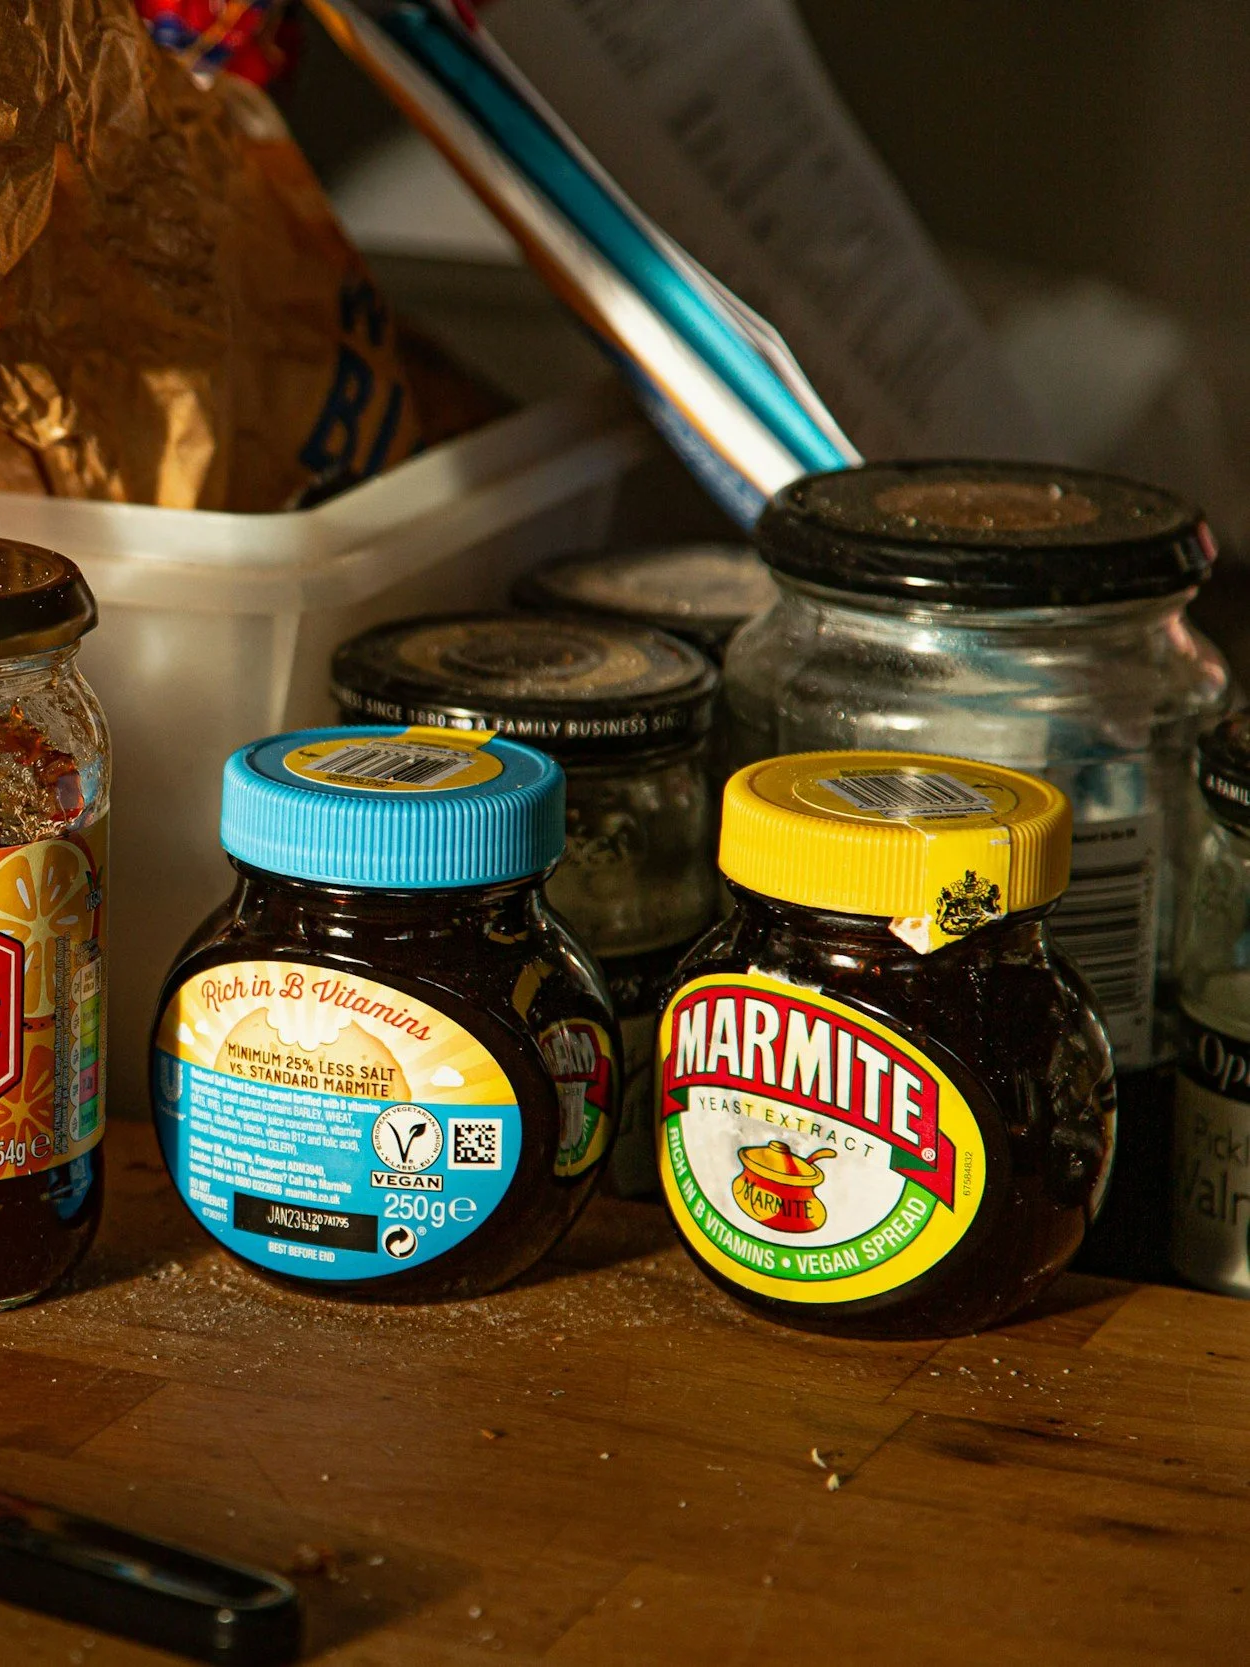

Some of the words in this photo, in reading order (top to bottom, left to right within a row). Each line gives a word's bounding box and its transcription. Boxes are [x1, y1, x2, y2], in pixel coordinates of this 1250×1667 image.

[365, 701, 403, 722] SINCE
[409, 710, 446, 728] 1880
[477, 718, 488, 732] A
[496, 719, 560, 736] FAMILY
[569, 718, 648, 737] BUSINESS
[1205, 773, 1215, 789] A
[201, 976, 248, 1012] Rich
[252, 974, 275, 997] in
[279, 972, 305, 1000] B
[312, 978, 431, 1041] Vitamins
[227, 1042, 281, 1067] MINIMUM
[286, 1056, 314, 1072] 25%
[319, 1060, 354, 1078] LESS
[360, 1065, 396, 1082] SALT
[229, 1061, 246, 1076] VS.
[250, 1065, 319, 1089] STANDARD
[324, 1078, 390, 1097] MARMITE
[674, 997, 924, 1147] MARMITE
[292, 1131, 305, 1143] B12
[374, 1111, 391, 1151] EUROPEAN
[392, 1106, 437, 1128] VEGETARIAN
[433, 1128, 441, 1154] UNION
[698, 1096, 753, 1117] YEAST
[765, 1108, 875, 1159] EXTRACT
[319, 1179, 351, 1192] Marmite
[373, 1173, 441, 1189] VEGAN
[735, 1177, 816, 1220] MARMITE
[267, 1205, 301, 1229] JAN23
[383, 1191, 446, 1228] 250g
[668, 1126, 687, 1176] RICH
[681, 1178, 700, 1197] IN
[693, 1201, 707, 1220] B
[705, 1212, 776, 1271] VITAMINS
[796, 1247, 861, 1276] VEGAN
[864, 1196, 929, 1262] SPREAD
[268, 1240, 287, 1255] BEST
[288, 1245, 318, 1260] BEFORE
[319, 1250, 336, 1263] END
